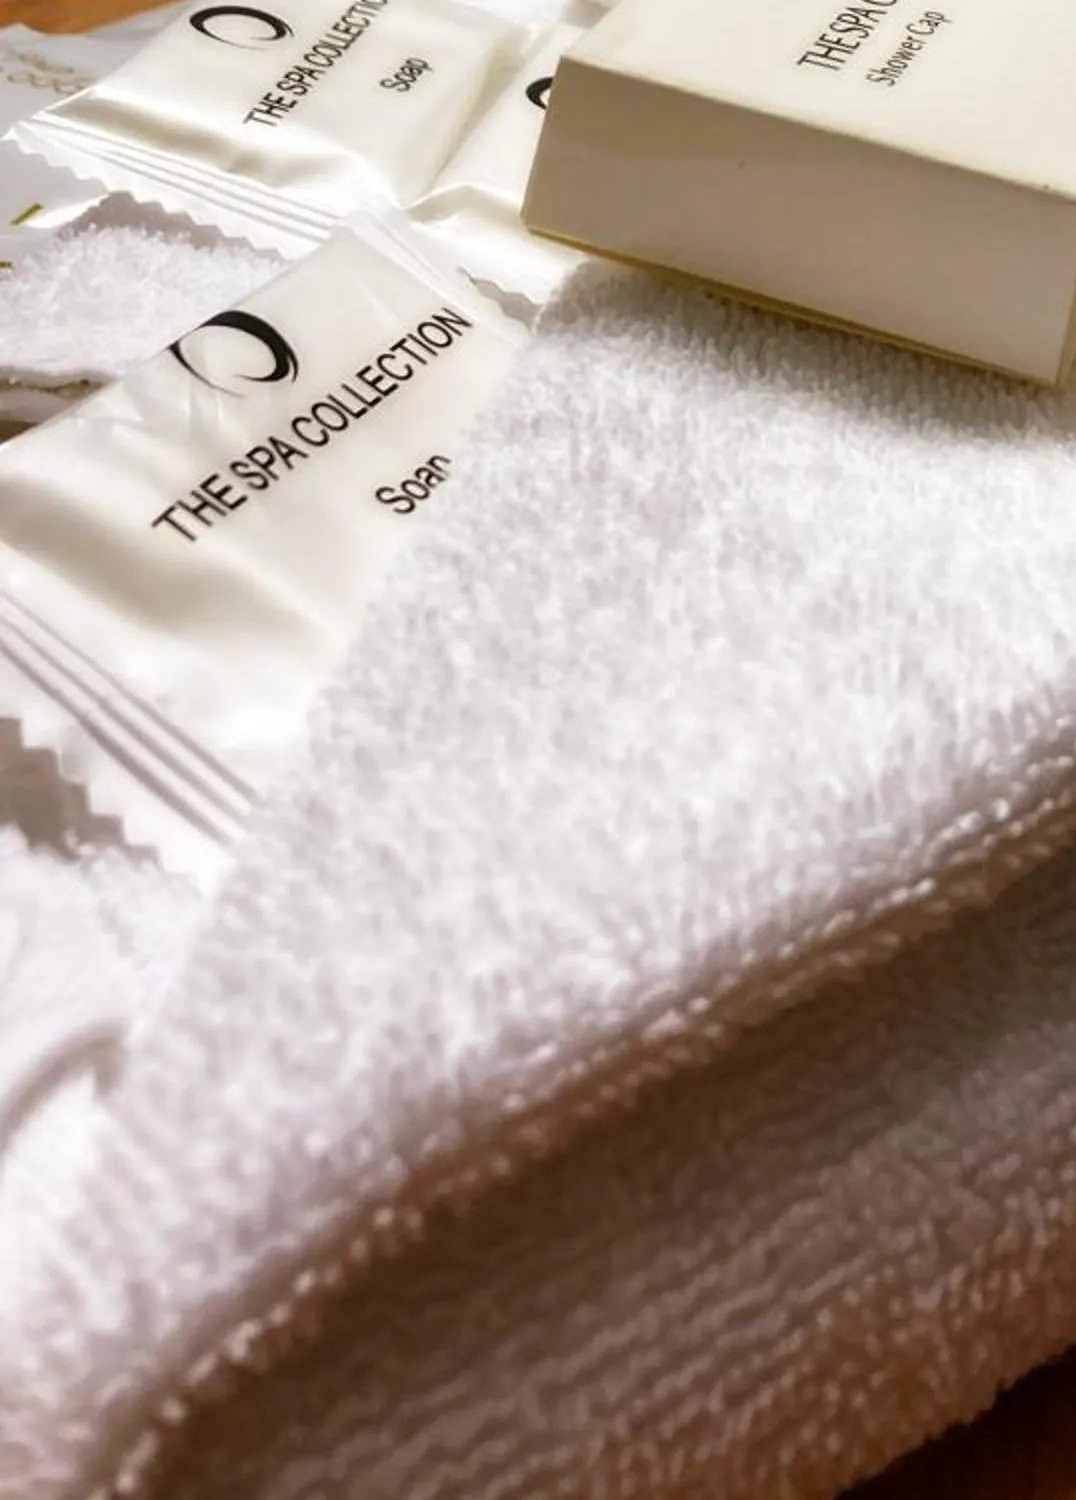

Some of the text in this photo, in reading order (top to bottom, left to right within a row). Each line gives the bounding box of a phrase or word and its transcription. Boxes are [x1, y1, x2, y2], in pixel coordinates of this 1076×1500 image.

[796, 33, 860, 71] THE
[829, 6, 887, 39] SPA
[865, 10, 952, 87] Shower Cap
[243, 92, 298, 127] THE
[276, 65, 326, 96] SPA
[379, 56, 434, 93] Soap
[151, 307, 474, 543] THE SPA COLLECTION
